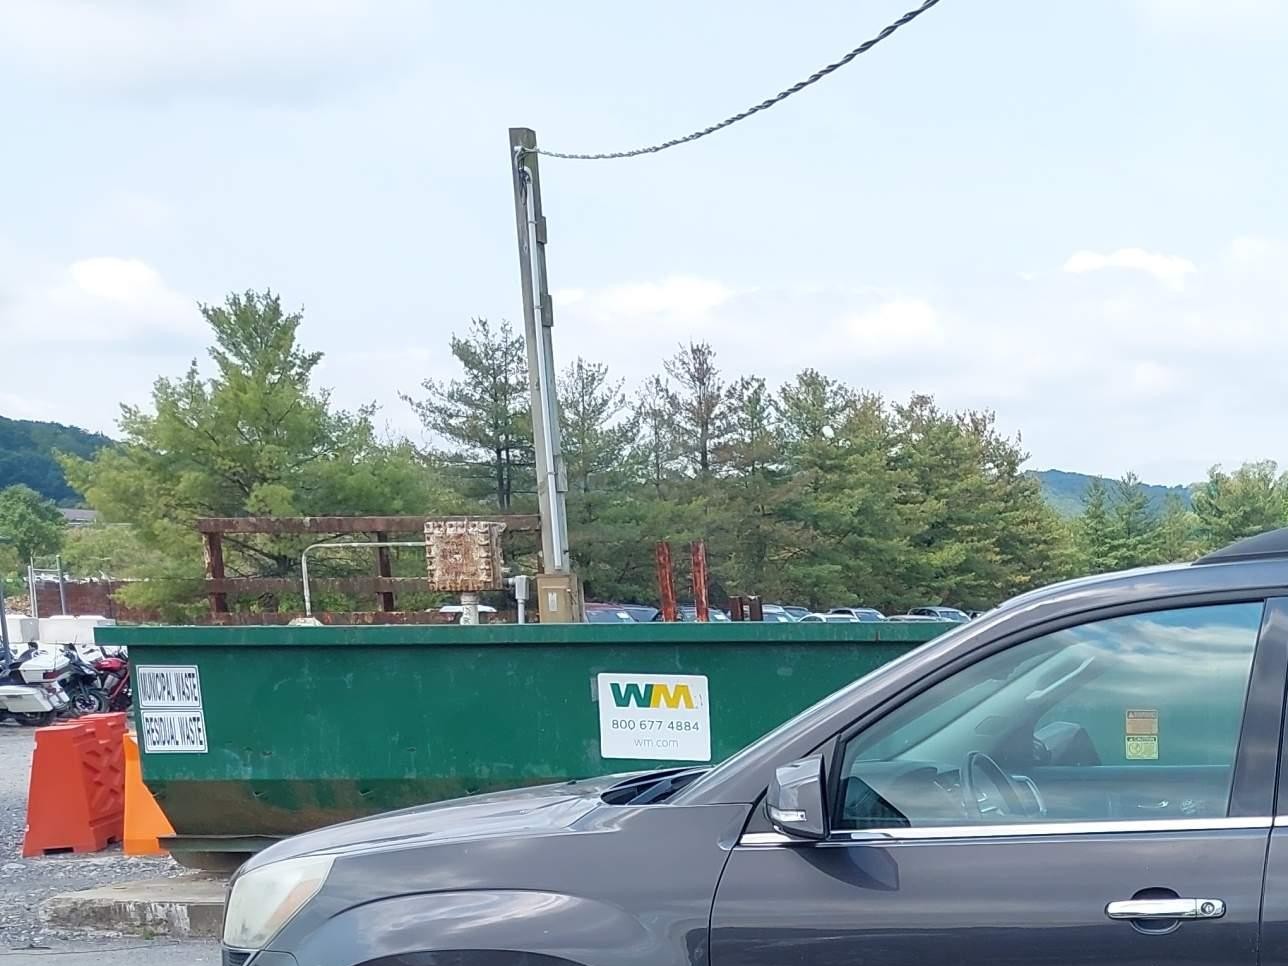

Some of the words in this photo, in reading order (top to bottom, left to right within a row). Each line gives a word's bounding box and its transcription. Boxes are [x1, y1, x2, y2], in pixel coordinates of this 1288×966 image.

[140, 672, 175, 701] MUNICIPAL
[175, 672, 198, 701] WASTE
[609, 682, 695, 709] WM
[145, 717, 179, 746] RESIDUAL
[178, 717, 203, 746] WASTE
[612, 719, 636, 730] 800
[639, 720, 663, 731] 677
[667, 721, 700, 732] 4884
